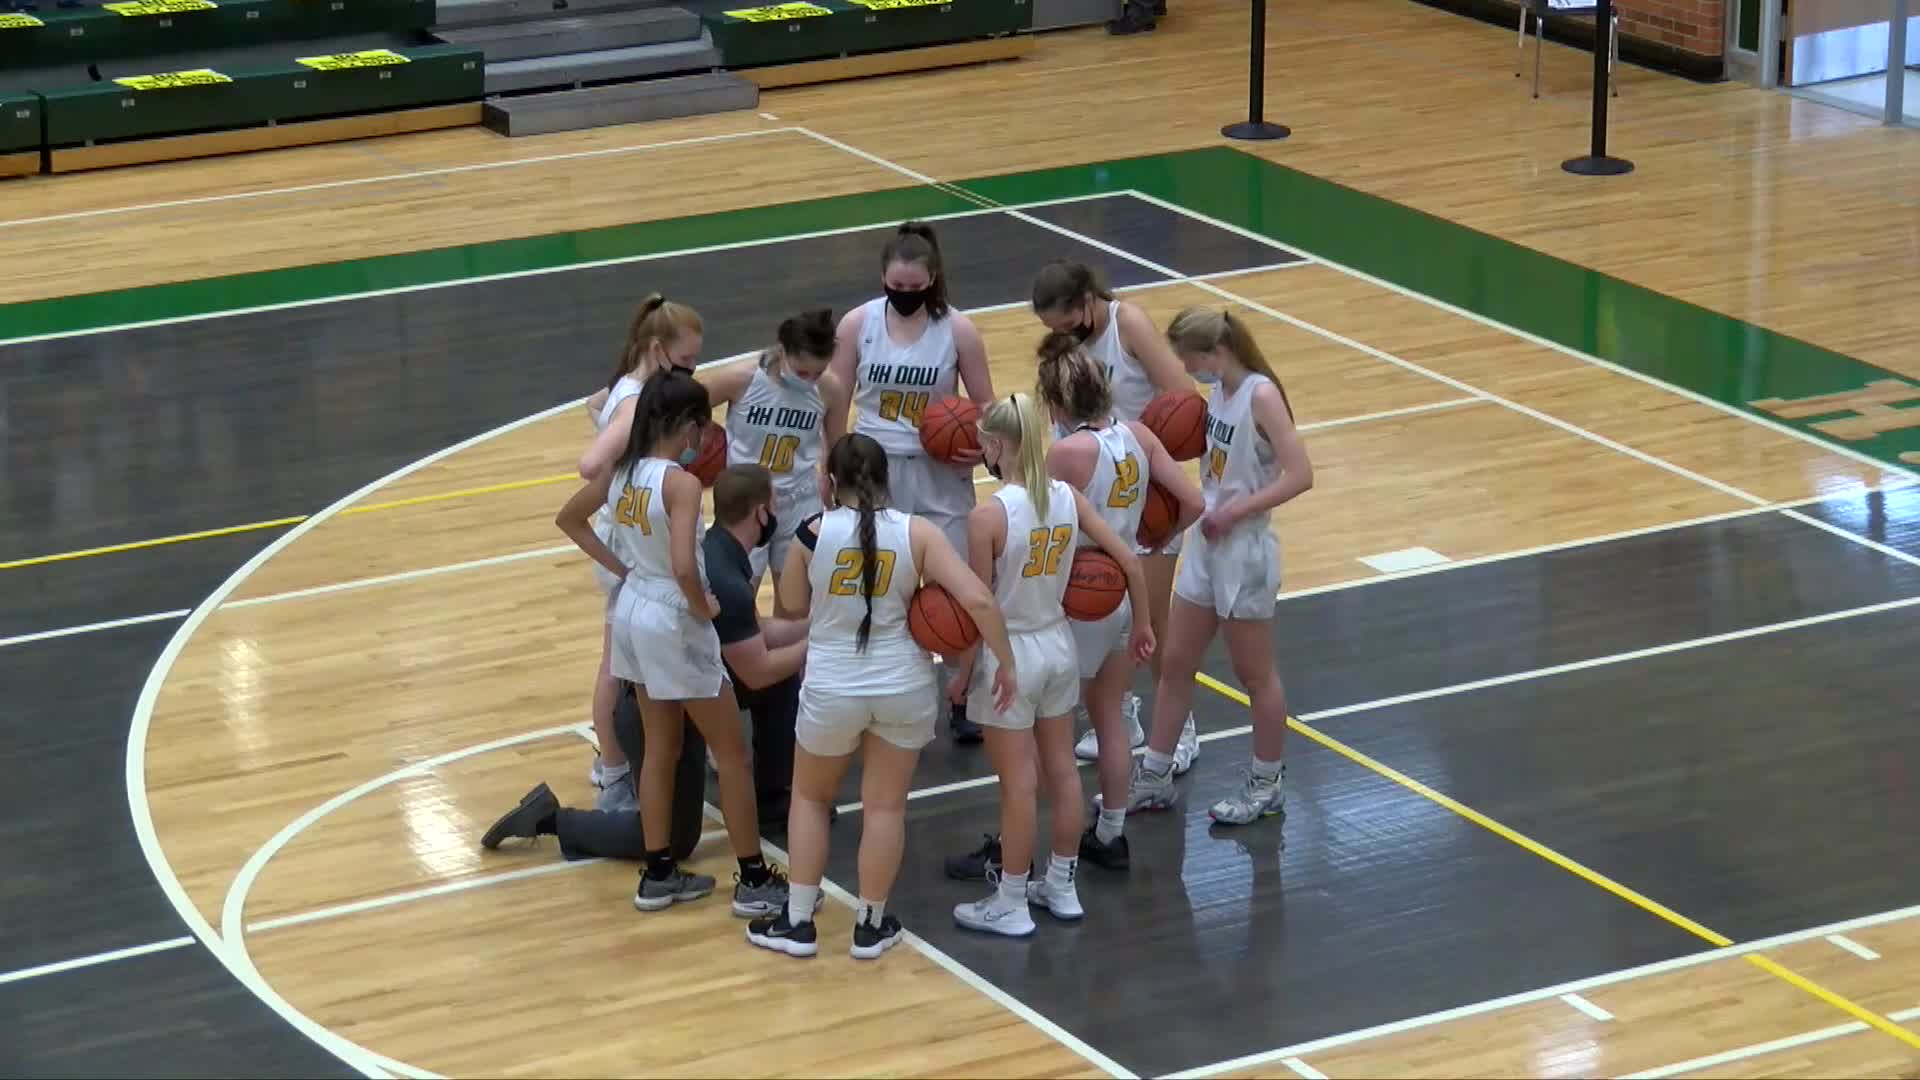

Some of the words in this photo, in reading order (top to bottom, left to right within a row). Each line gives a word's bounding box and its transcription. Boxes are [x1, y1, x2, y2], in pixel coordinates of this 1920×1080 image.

[868, 363, 893, 384] HH
[894, 365, 939, 387] DOW
[747, 405, 774, 426] HH
[775, 407, 817, 430] DOW
[615, 479, 653, 537] 24
[828, 547, 897, 597] 20
[1021, 523, 1073, 578] 32
